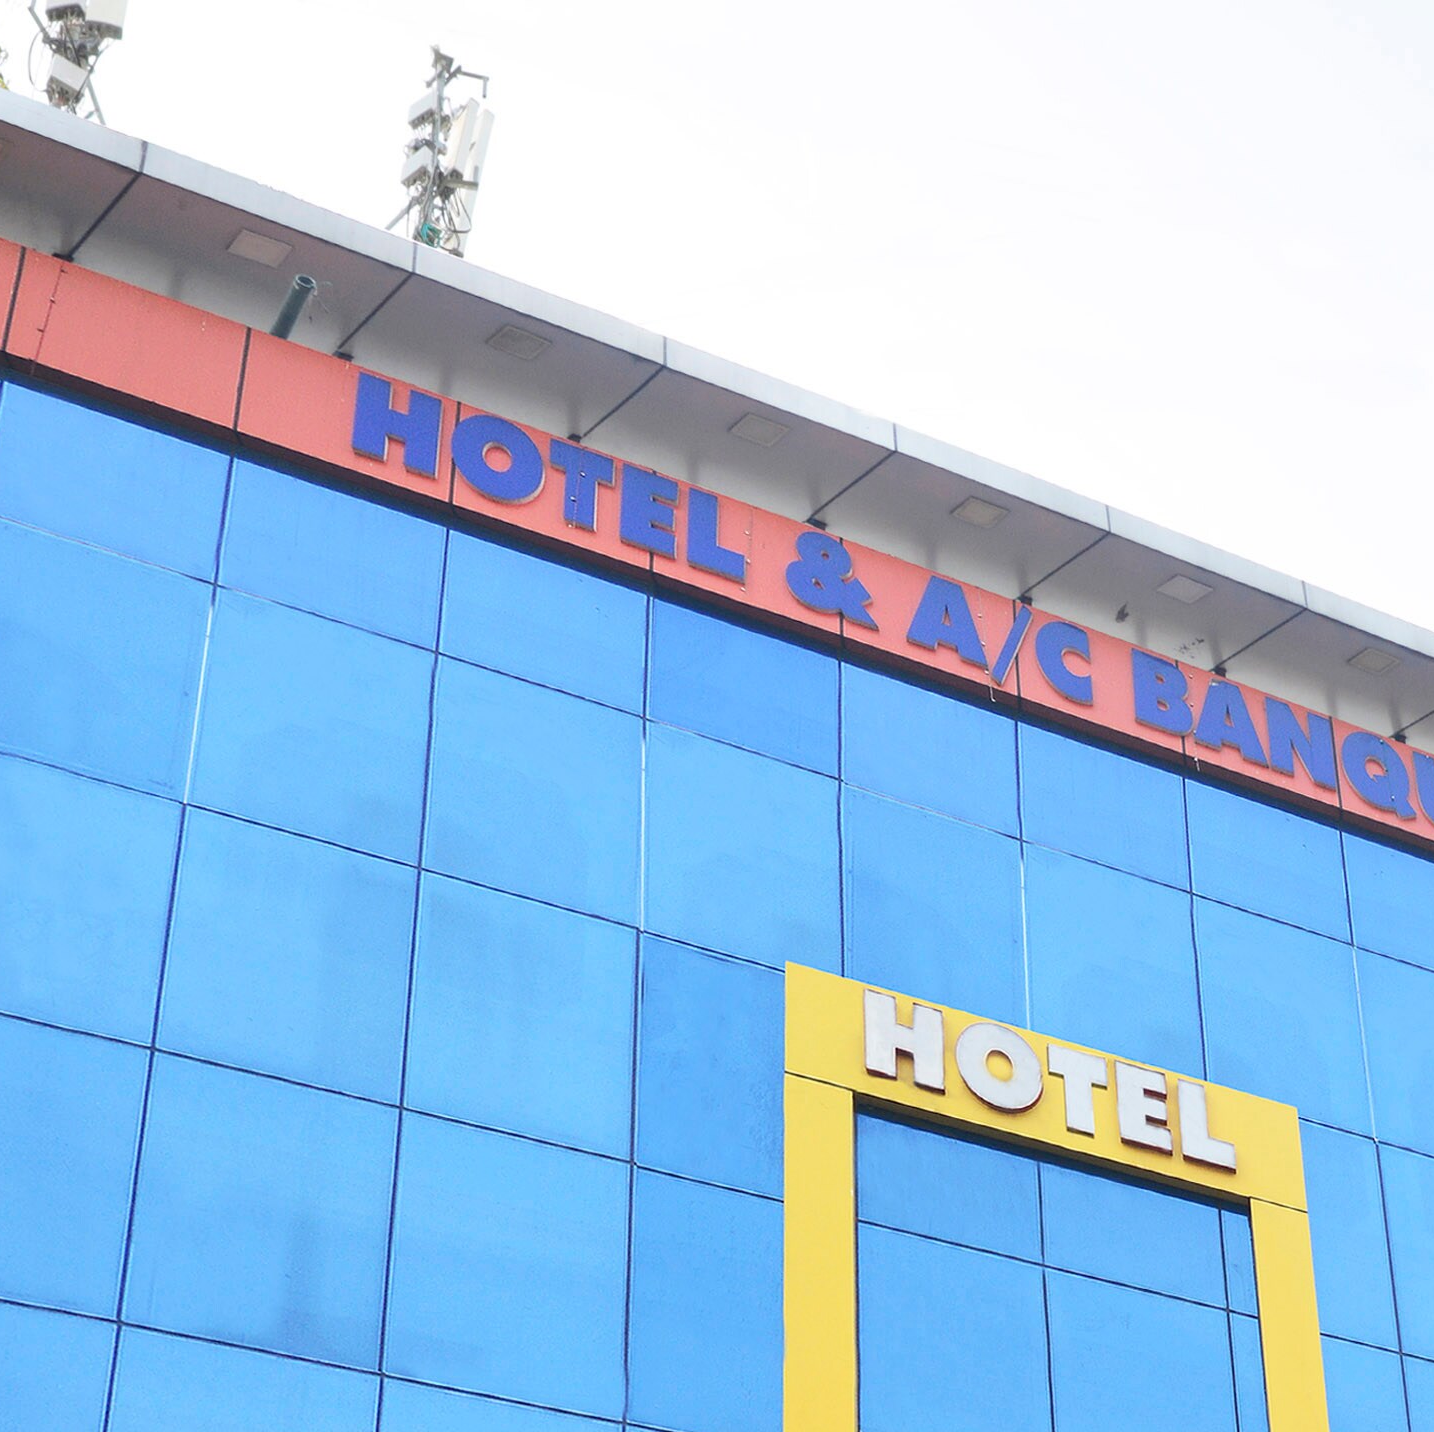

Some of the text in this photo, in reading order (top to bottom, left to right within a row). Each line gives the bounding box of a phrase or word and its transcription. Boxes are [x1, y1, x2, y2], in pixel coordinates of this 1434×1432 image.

[352, 369, 747, 585] HOTEL
[785, 531, 878, 631] &
[907, 576, 1094, 707] A/C
[864, 988, 1236, 1174] HOTEL
